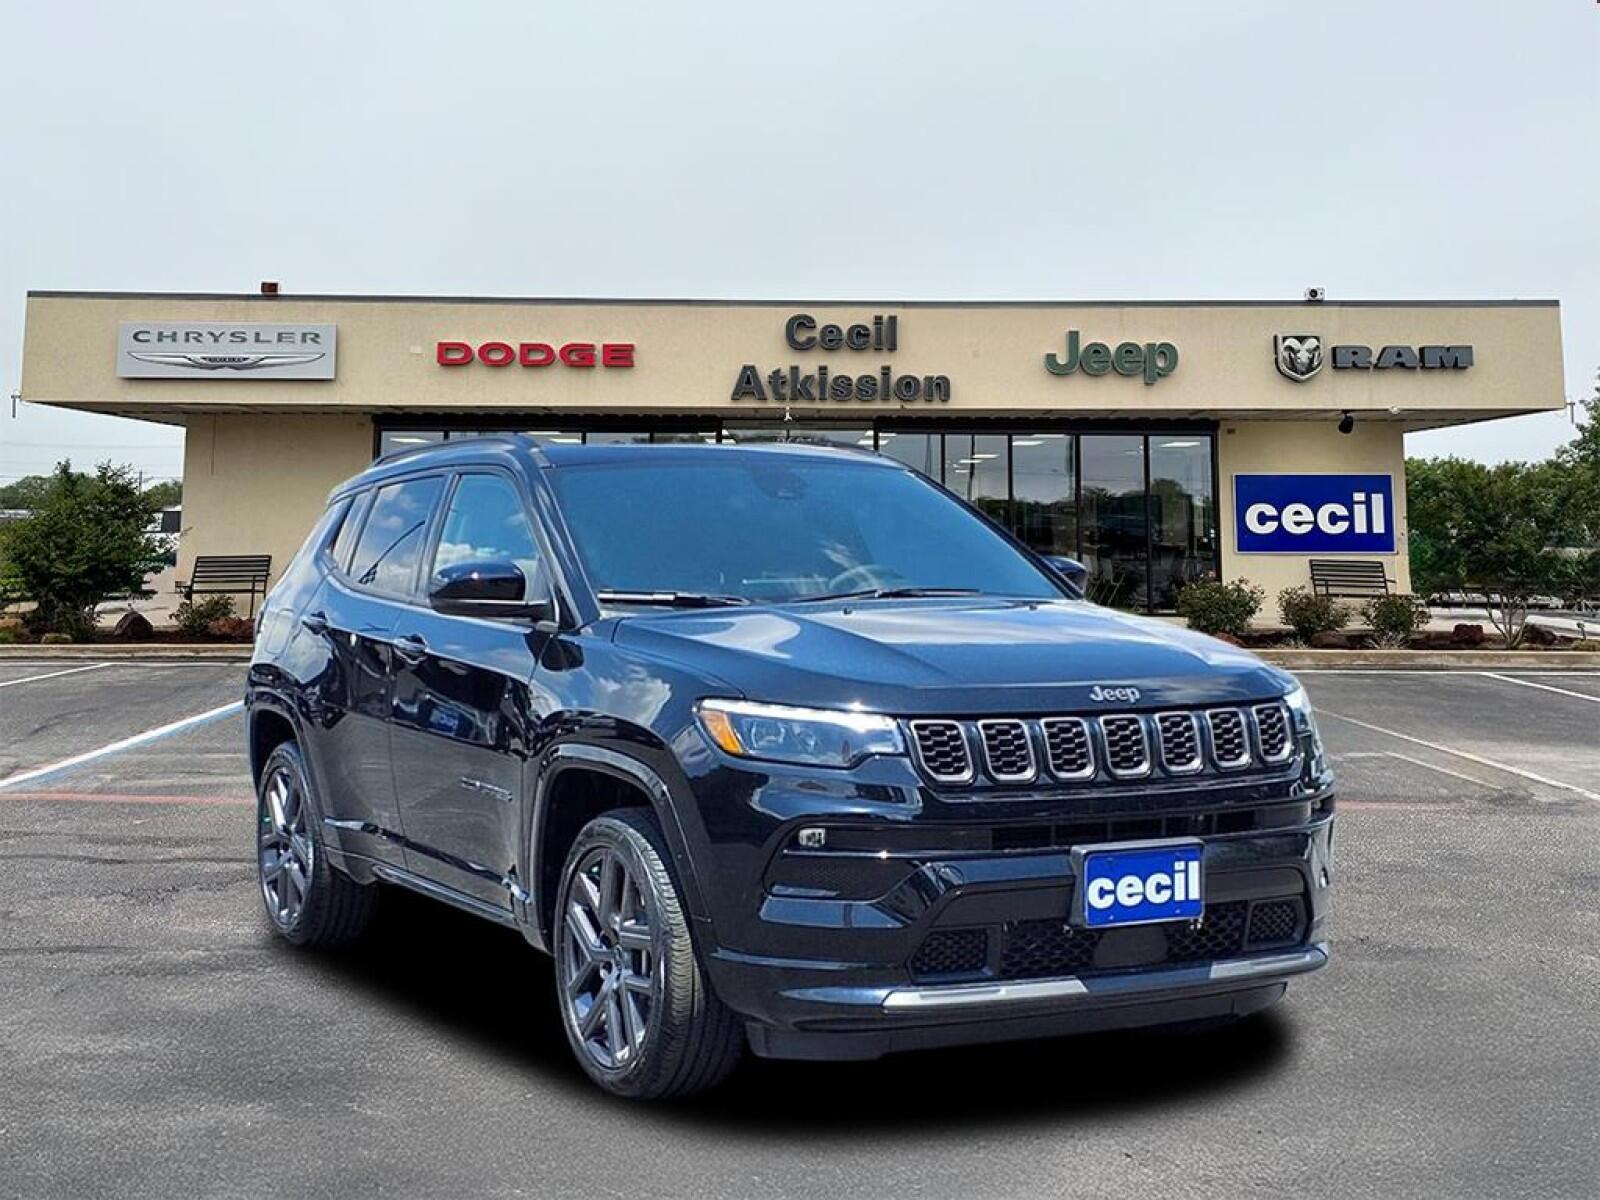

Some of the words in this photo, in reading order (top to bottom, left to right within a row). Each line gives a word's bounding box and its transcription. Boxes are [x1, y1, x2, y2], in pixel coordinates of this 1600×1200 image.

[132, 330, 322, 345] CHRYSLER
[785, 314, 898, 351] Cecil
[437, 342, 635, 368] DODGE
[1045, 330, 1179, 386] Jeep
[1331, 345, 1474, 370] RAM
[731, 365, 951, 401] Atkission
[1245, 491, 1385, 534] cecil
[1089, 685, 1140, 704] Jeep
[1088, 860, 1200, 909] cecil
